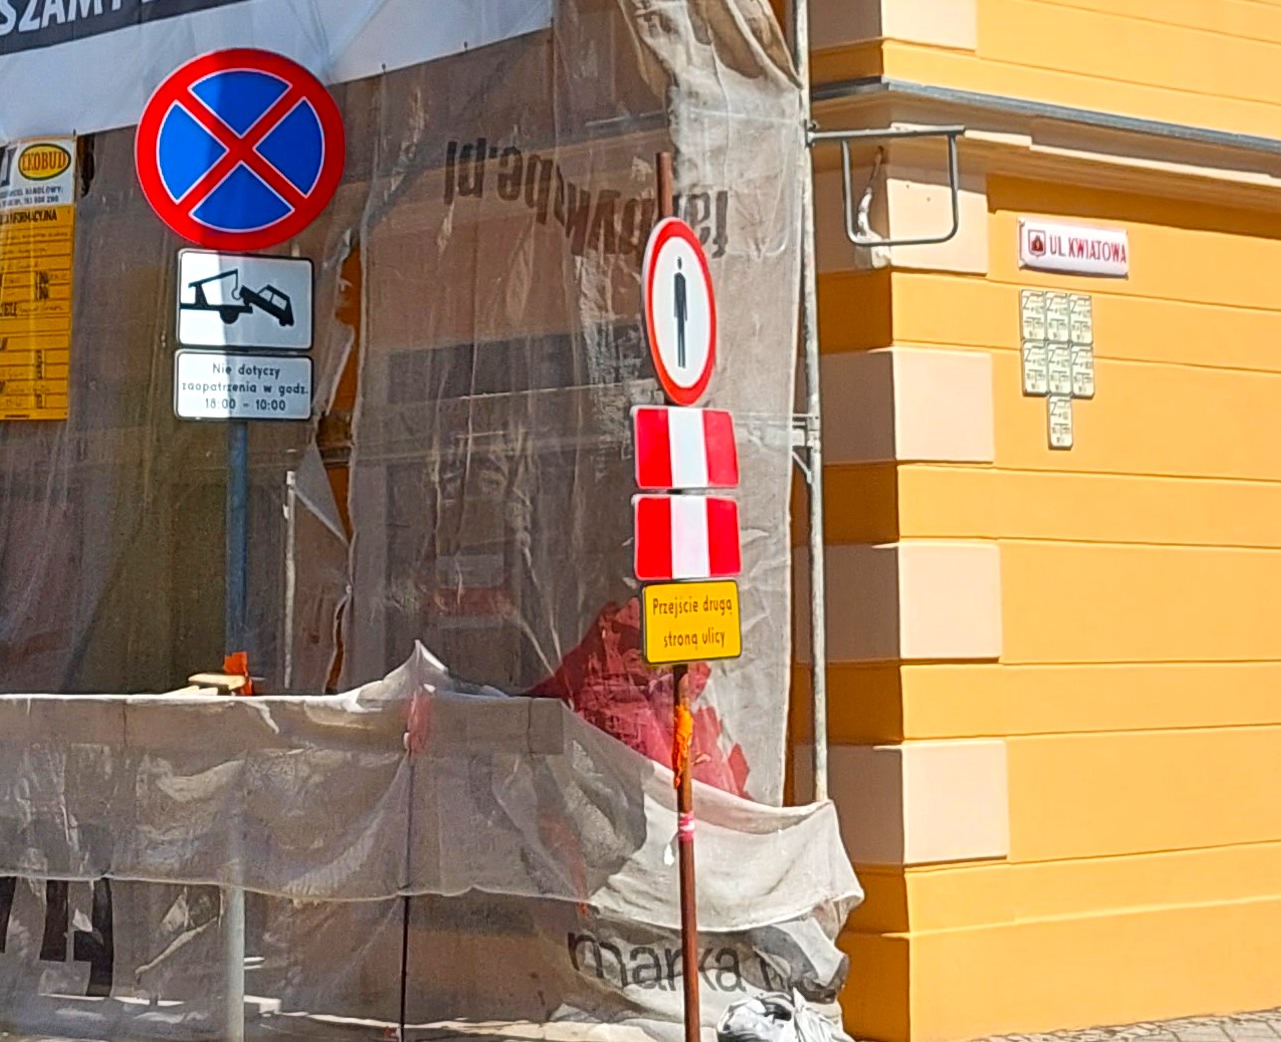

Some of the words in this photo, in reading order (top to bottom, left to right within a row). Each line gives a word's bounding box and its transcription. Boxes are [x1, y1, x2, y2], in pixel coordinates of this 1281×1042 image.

[1068, 237, 1127, 263] KWIATOWA
[212, 363, 231, 375] Nie
[238, 363, 280, 379] dotyczy
[182, 381, 256, 394] zaopatrzenia
[279, 383, 308, 397] godz.
[256, 399, 286, 410] 10:00
[653, 596, 698, 618] Przejście
[703, 595, 732, 616] drugą
[663, 631, 698, 650] stroną
[702, 627, 725, 648] ulicy
